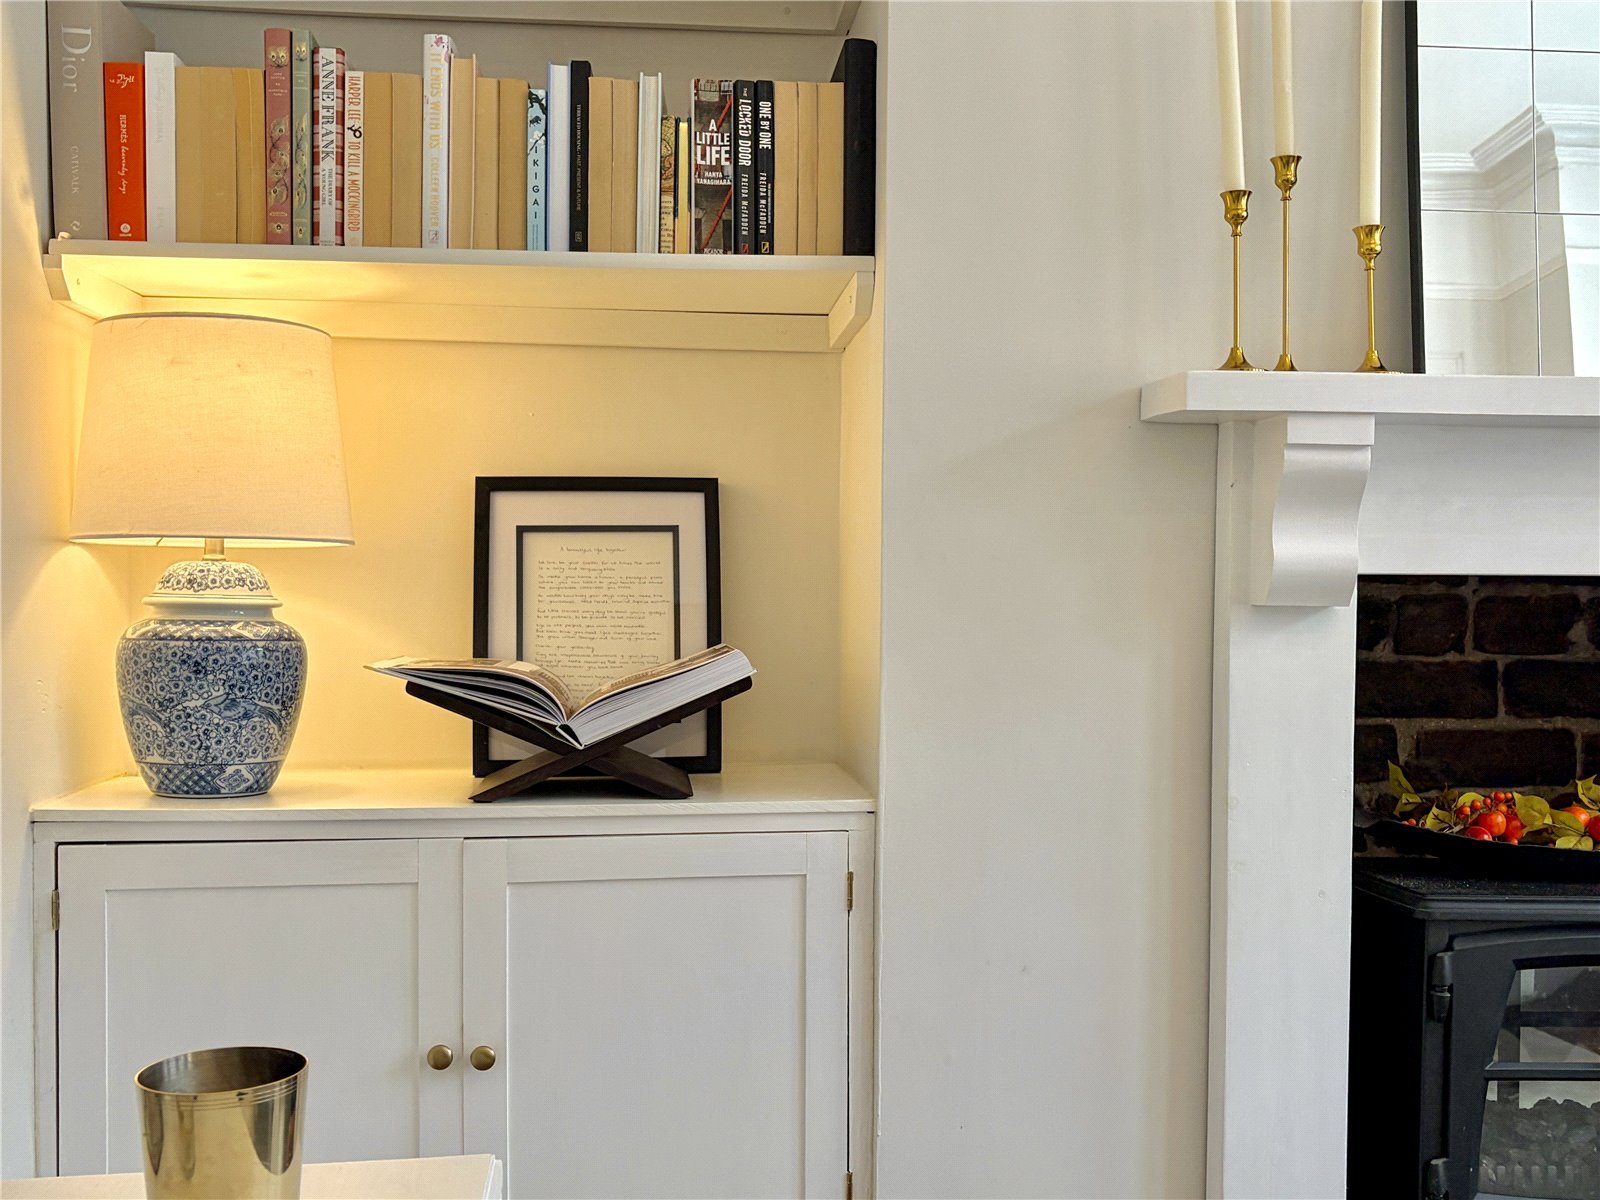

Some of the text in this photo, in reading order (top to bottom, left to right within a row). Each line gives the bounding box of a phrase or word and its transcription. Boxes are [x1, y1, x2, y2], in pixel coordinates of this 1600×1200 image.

[61, 23, 92, 93] Dior
[321, 55, 335, 162] ANNE FRANK
[348, 76, 361, 121] HARPER LEE
[429, 52, 443, 149] IT ENDS WITH US
[738, 99, 752, 136] LOCKED
[348, 141, 361, 150] TO
[696, 132, 730, 145] LITTLE
[709, 119, 718, 131] A
[759, 101, 772, 149] ONE BY ONE
[70, 145, 80, 194] CATWALK
[348, 152, 361, 168] KILL
[696, 145, 730, 166] LIFE
[738, 139, 752, 166] DOOR
[347, 179, 360, 232] MOCKINGBIRD
[430, 156, 440, 227] COLLEEN HOOVER
[532, 146, 540, 219] IKIGAI
[741, 173, 749, 236] FREIDA McFADDEN
[759, 172, 767, 234] FREIDA McFADDEN
